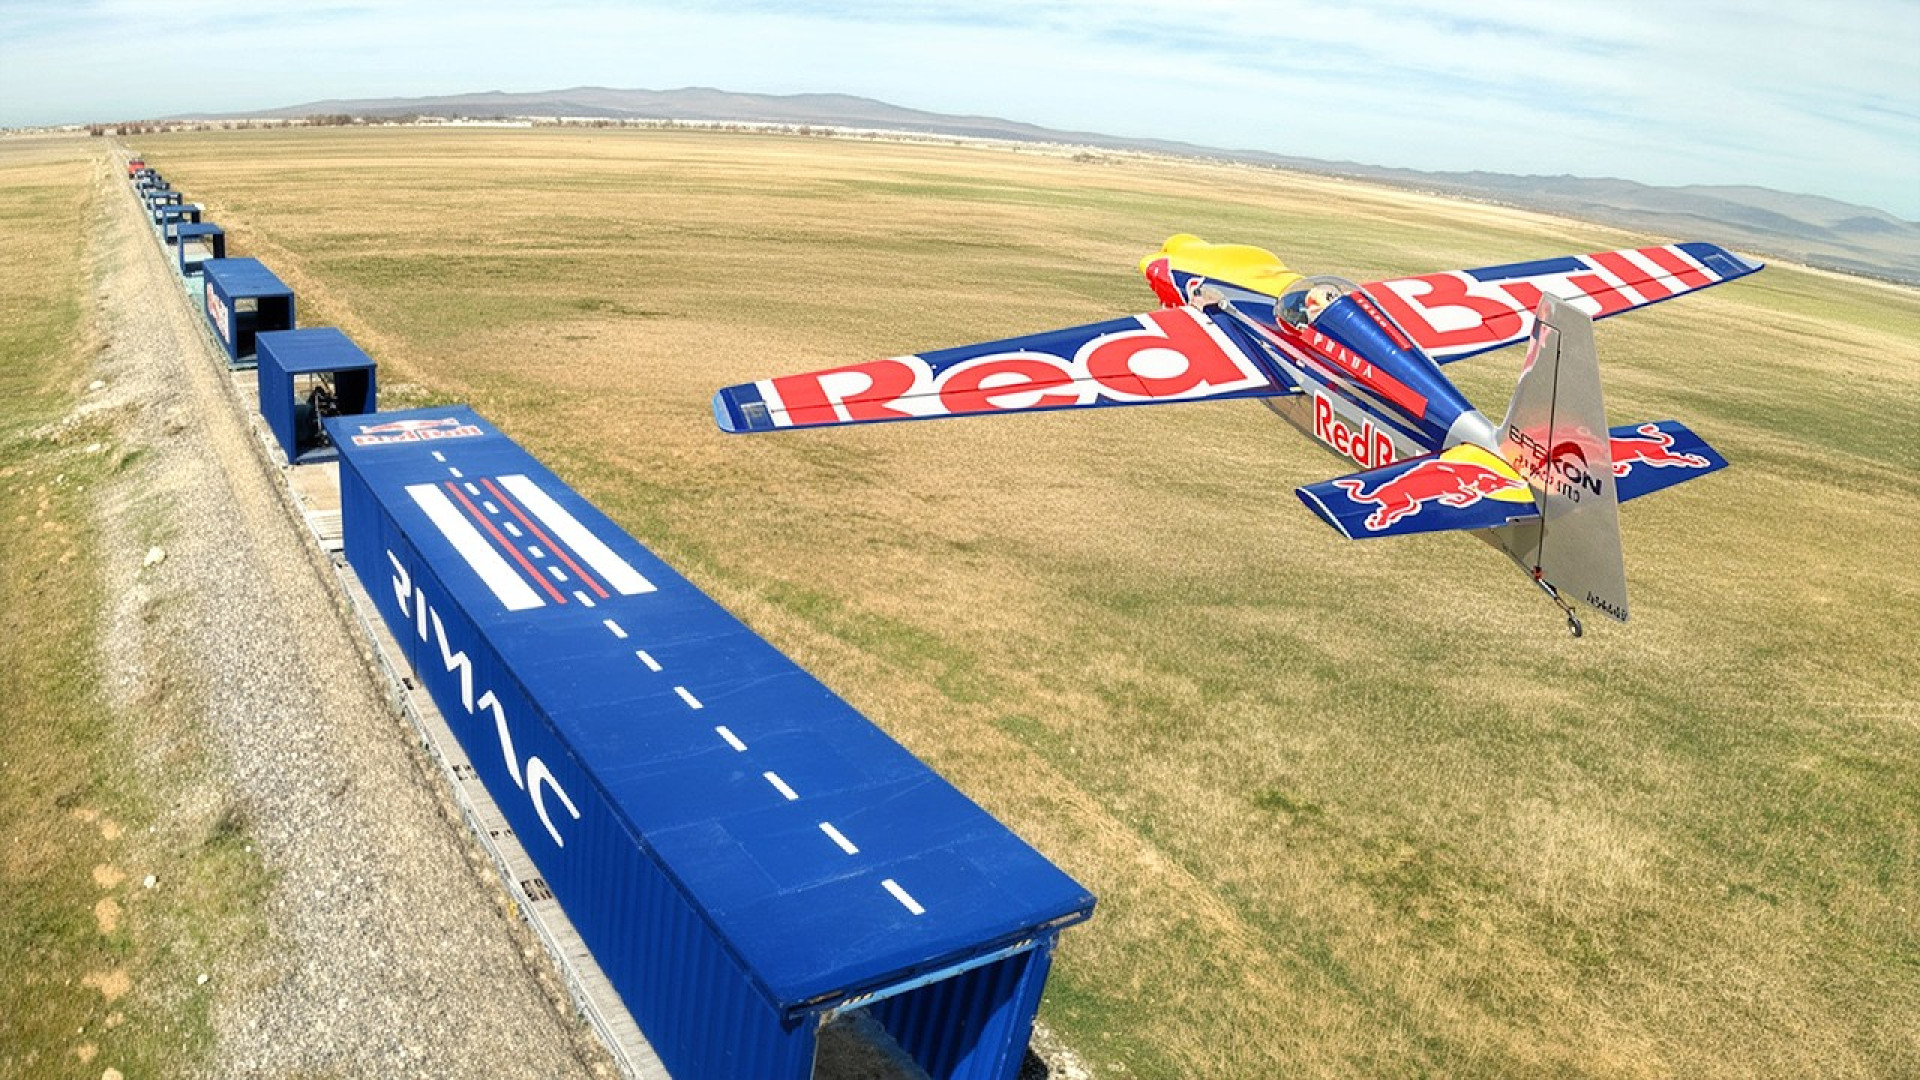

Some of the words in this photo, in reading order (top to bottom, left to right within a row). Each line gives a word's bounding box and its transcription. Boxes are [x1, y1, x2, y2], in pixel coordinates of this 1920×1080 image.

[768, 306, 1250, 426] Red
[1313, 332, 1373, 379] PRADA
[1313, 390, 1373, 469] Red
[386, 548, 580, 848] RIMAC
